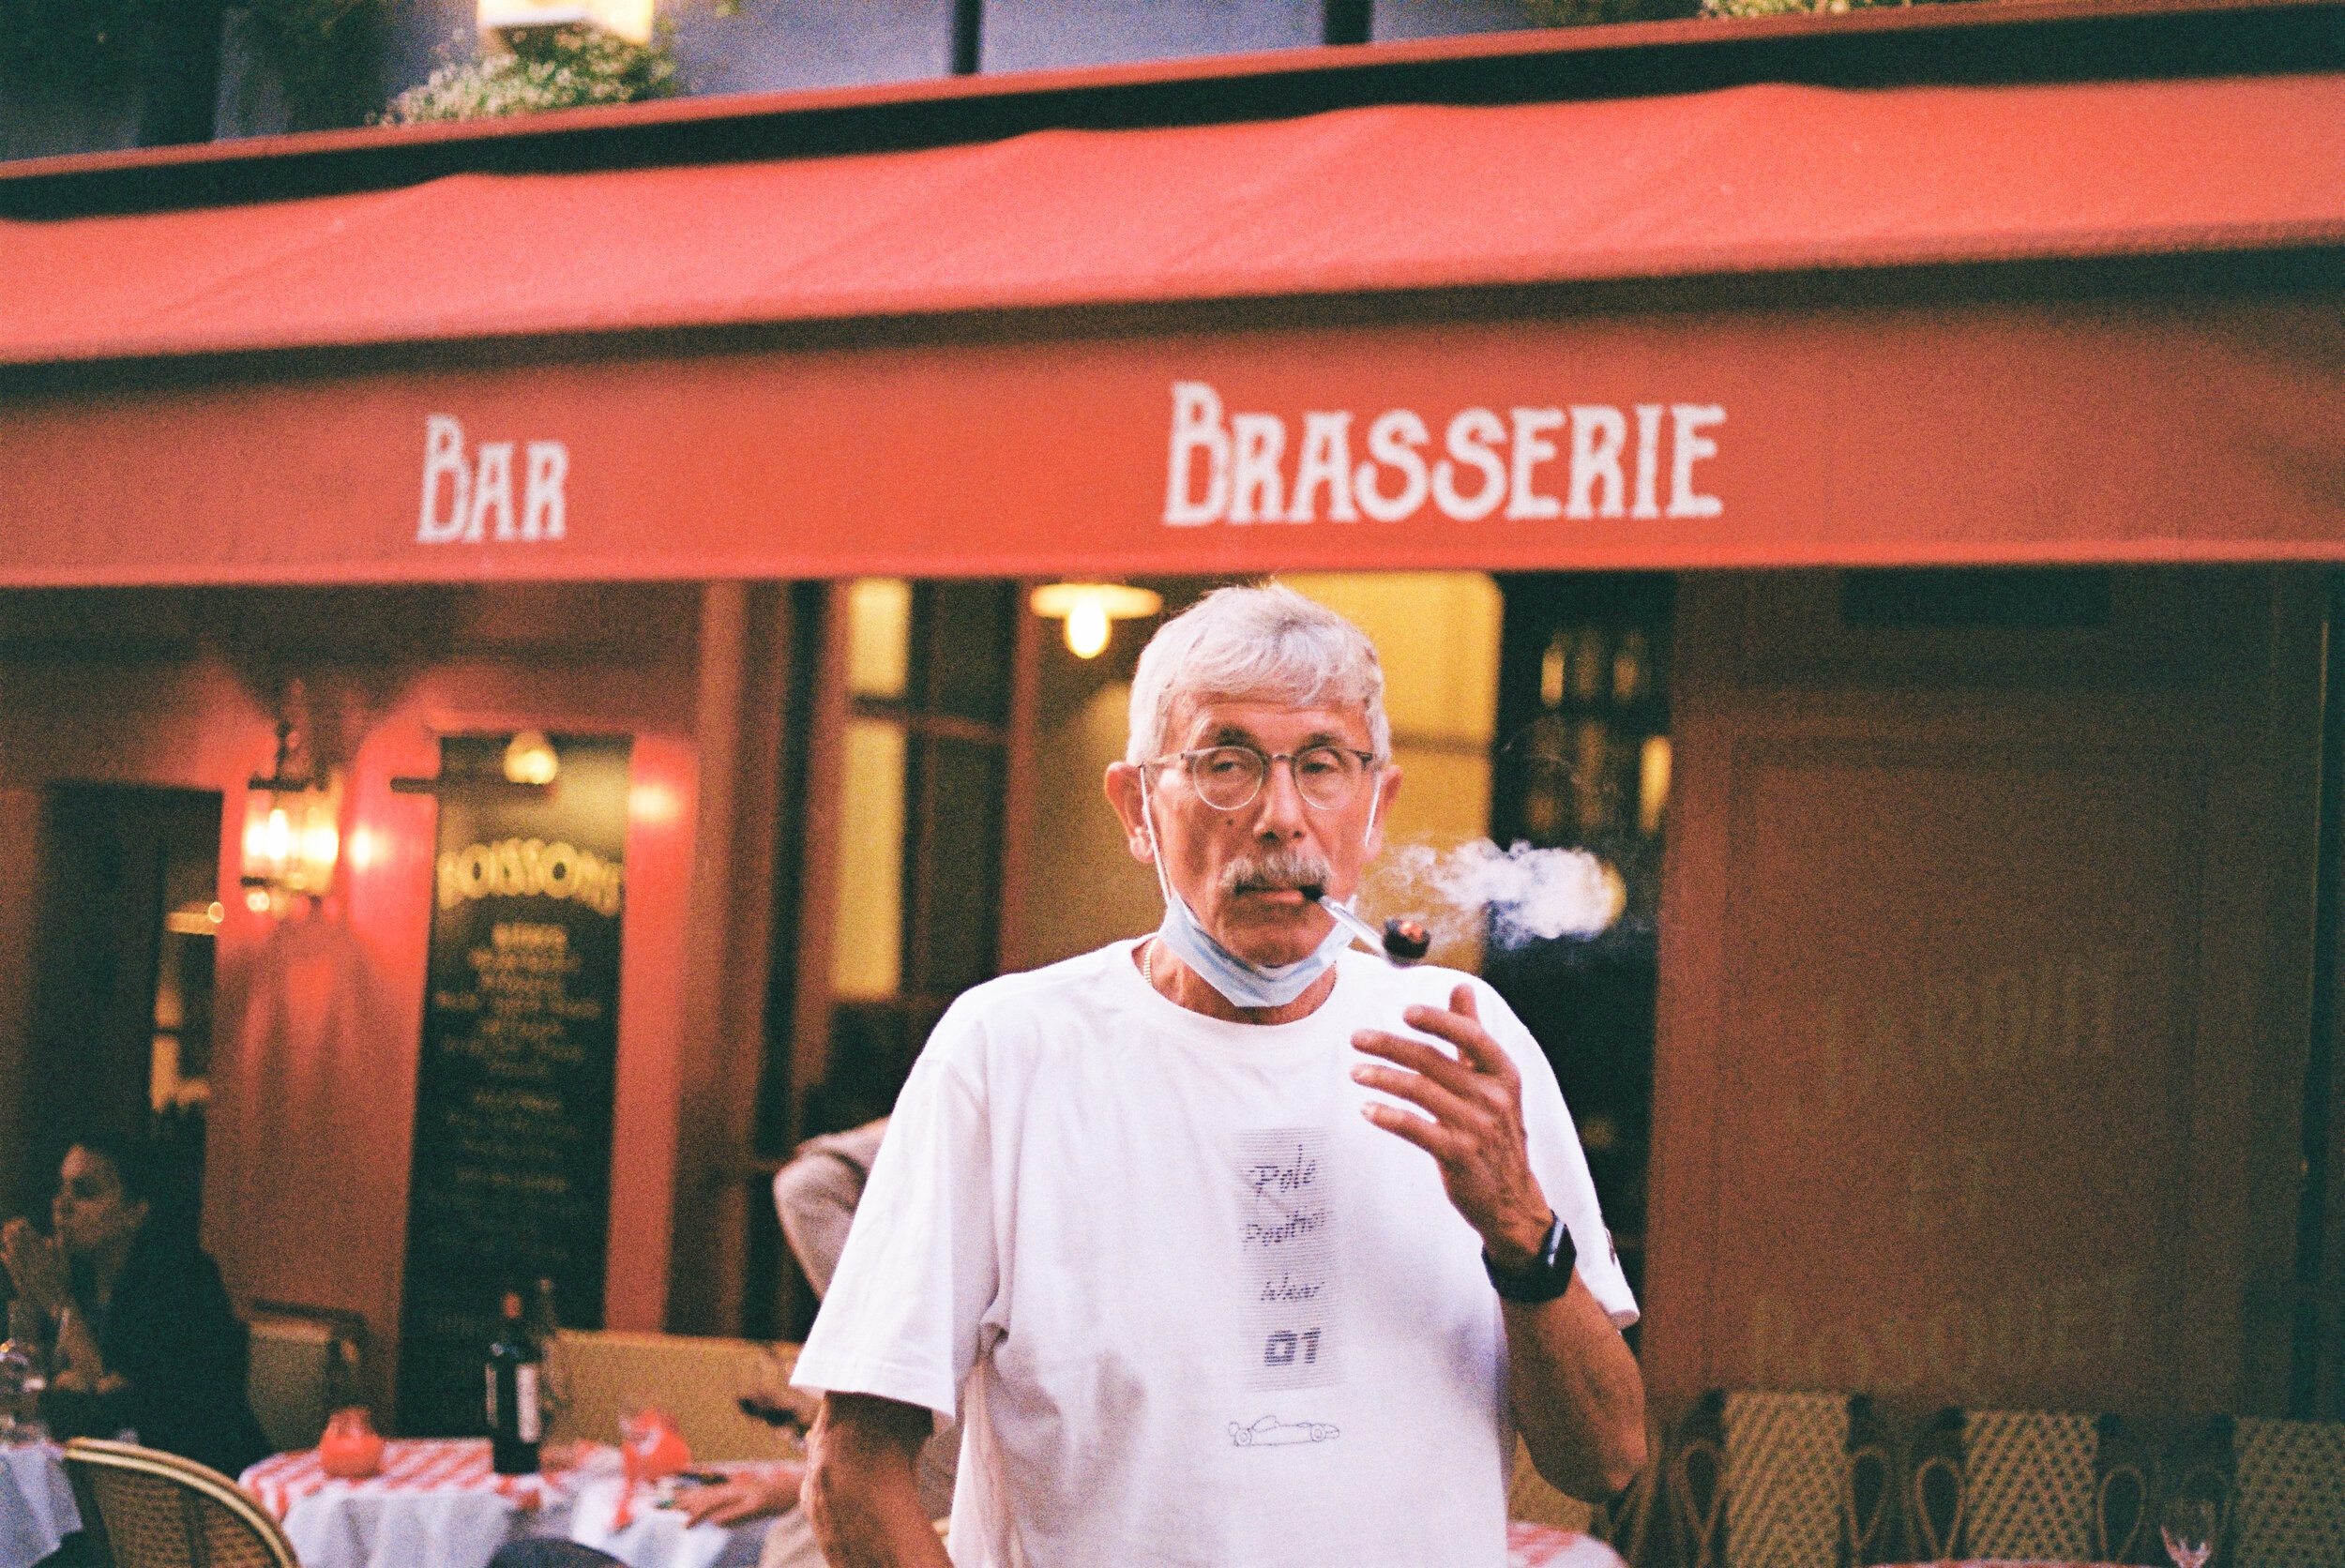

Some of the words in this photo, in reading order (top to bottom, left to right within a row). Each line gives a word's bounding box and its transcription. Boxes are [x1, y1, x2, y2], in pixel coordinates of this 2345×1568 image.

[416, 413, 569, 543] BAR
[1163, 380, 1727, 526] BRASSERIE
[1247, 1143, 1317, 1201] Pole
[1264, 1328, 1322, 1367] 01
